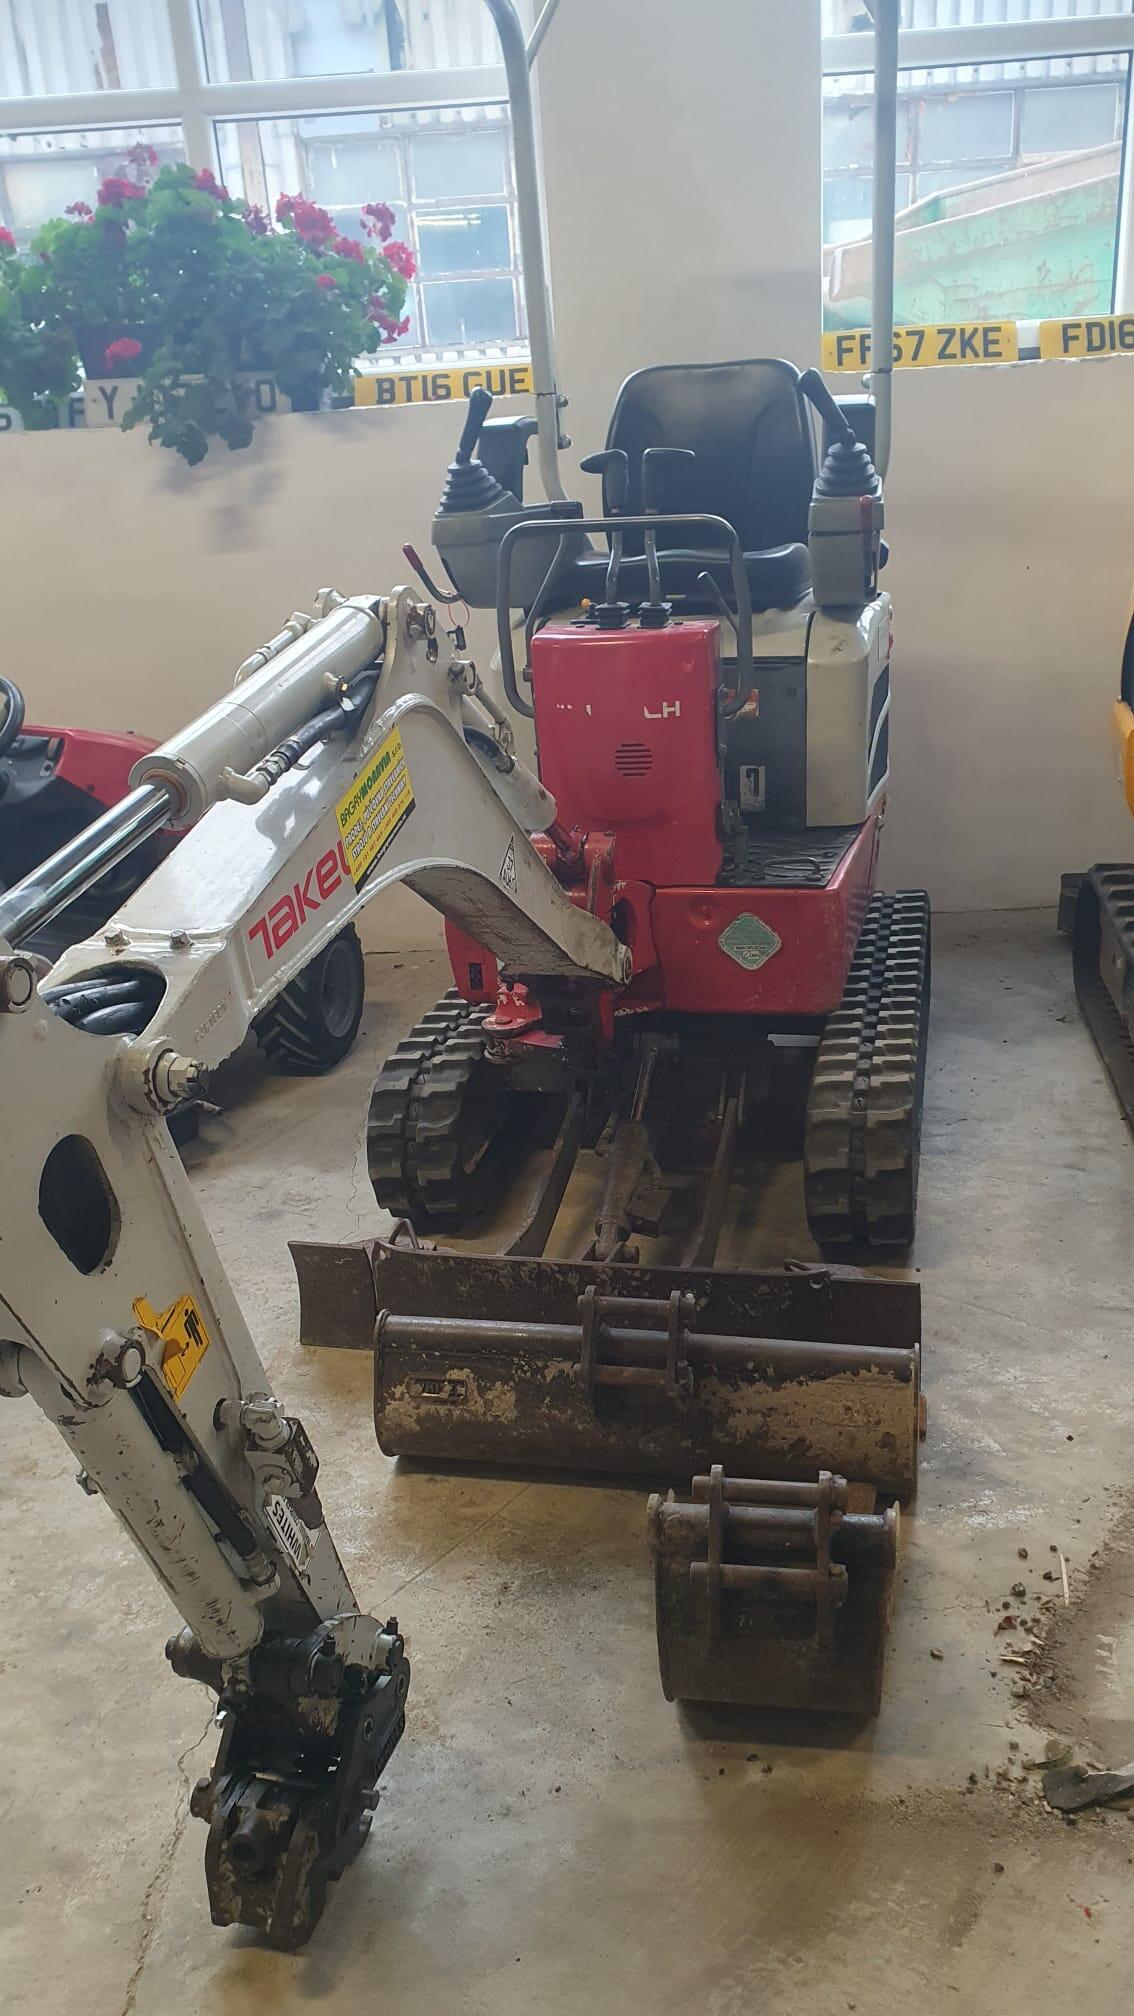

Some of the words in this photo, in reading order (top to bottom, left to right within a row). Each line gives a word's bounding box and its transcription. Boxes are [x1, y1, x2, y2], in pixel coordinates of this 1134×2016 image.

[937, 325, 1003, 361] ZKE
[1062, 319, 1134, 354] FD16
[376, 373, 452, 405] BT16
